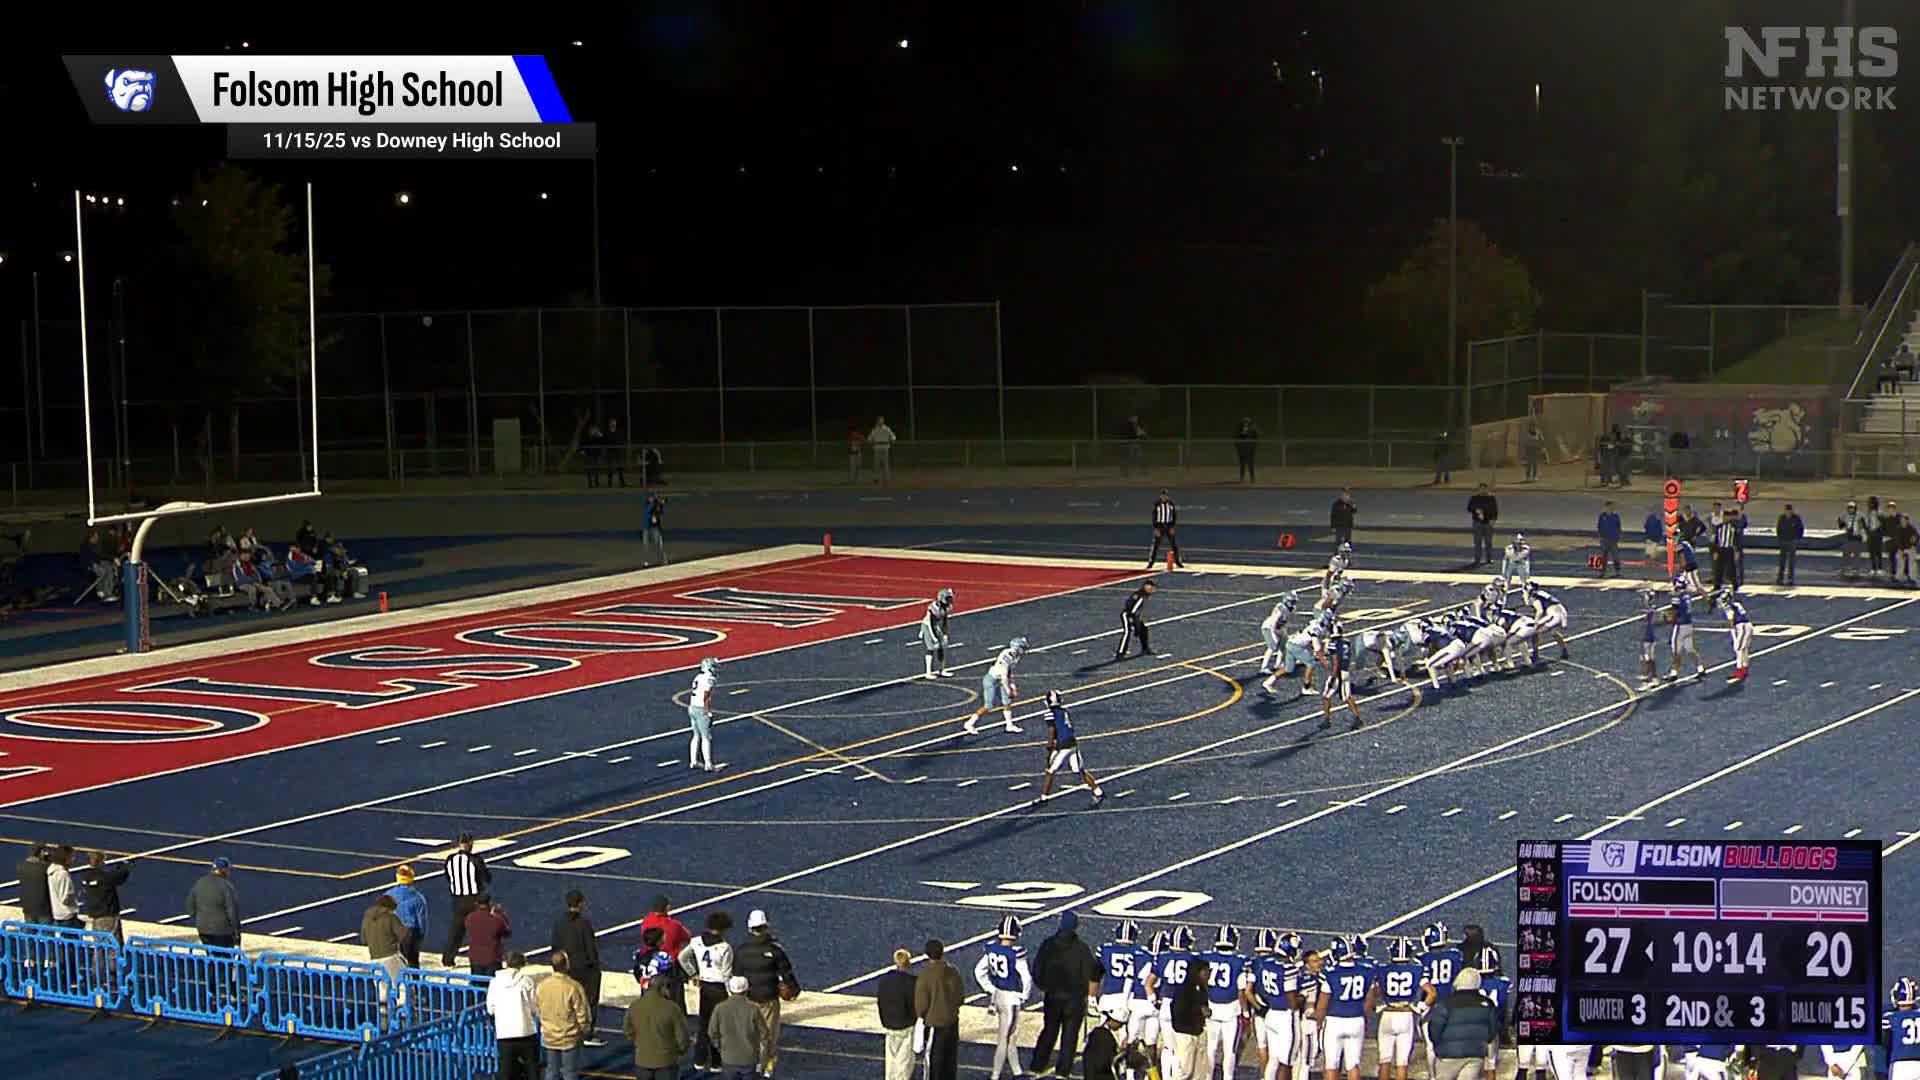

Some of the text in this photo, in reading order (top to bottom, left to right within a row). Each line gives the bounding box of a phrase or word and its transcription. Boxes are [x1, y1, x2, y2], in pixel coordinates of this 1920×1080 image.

[954, 881, 1214, 918] 20
[702, 950, 713, 969] 4
[1163, 959, 1188, 985] 46
[1430, 958, 1452, 985] 18
[1207, 961, 1232, 988] 73
[1385, 971, 1412, 997] 62
[1339, 975, 1365, 1001] 78
